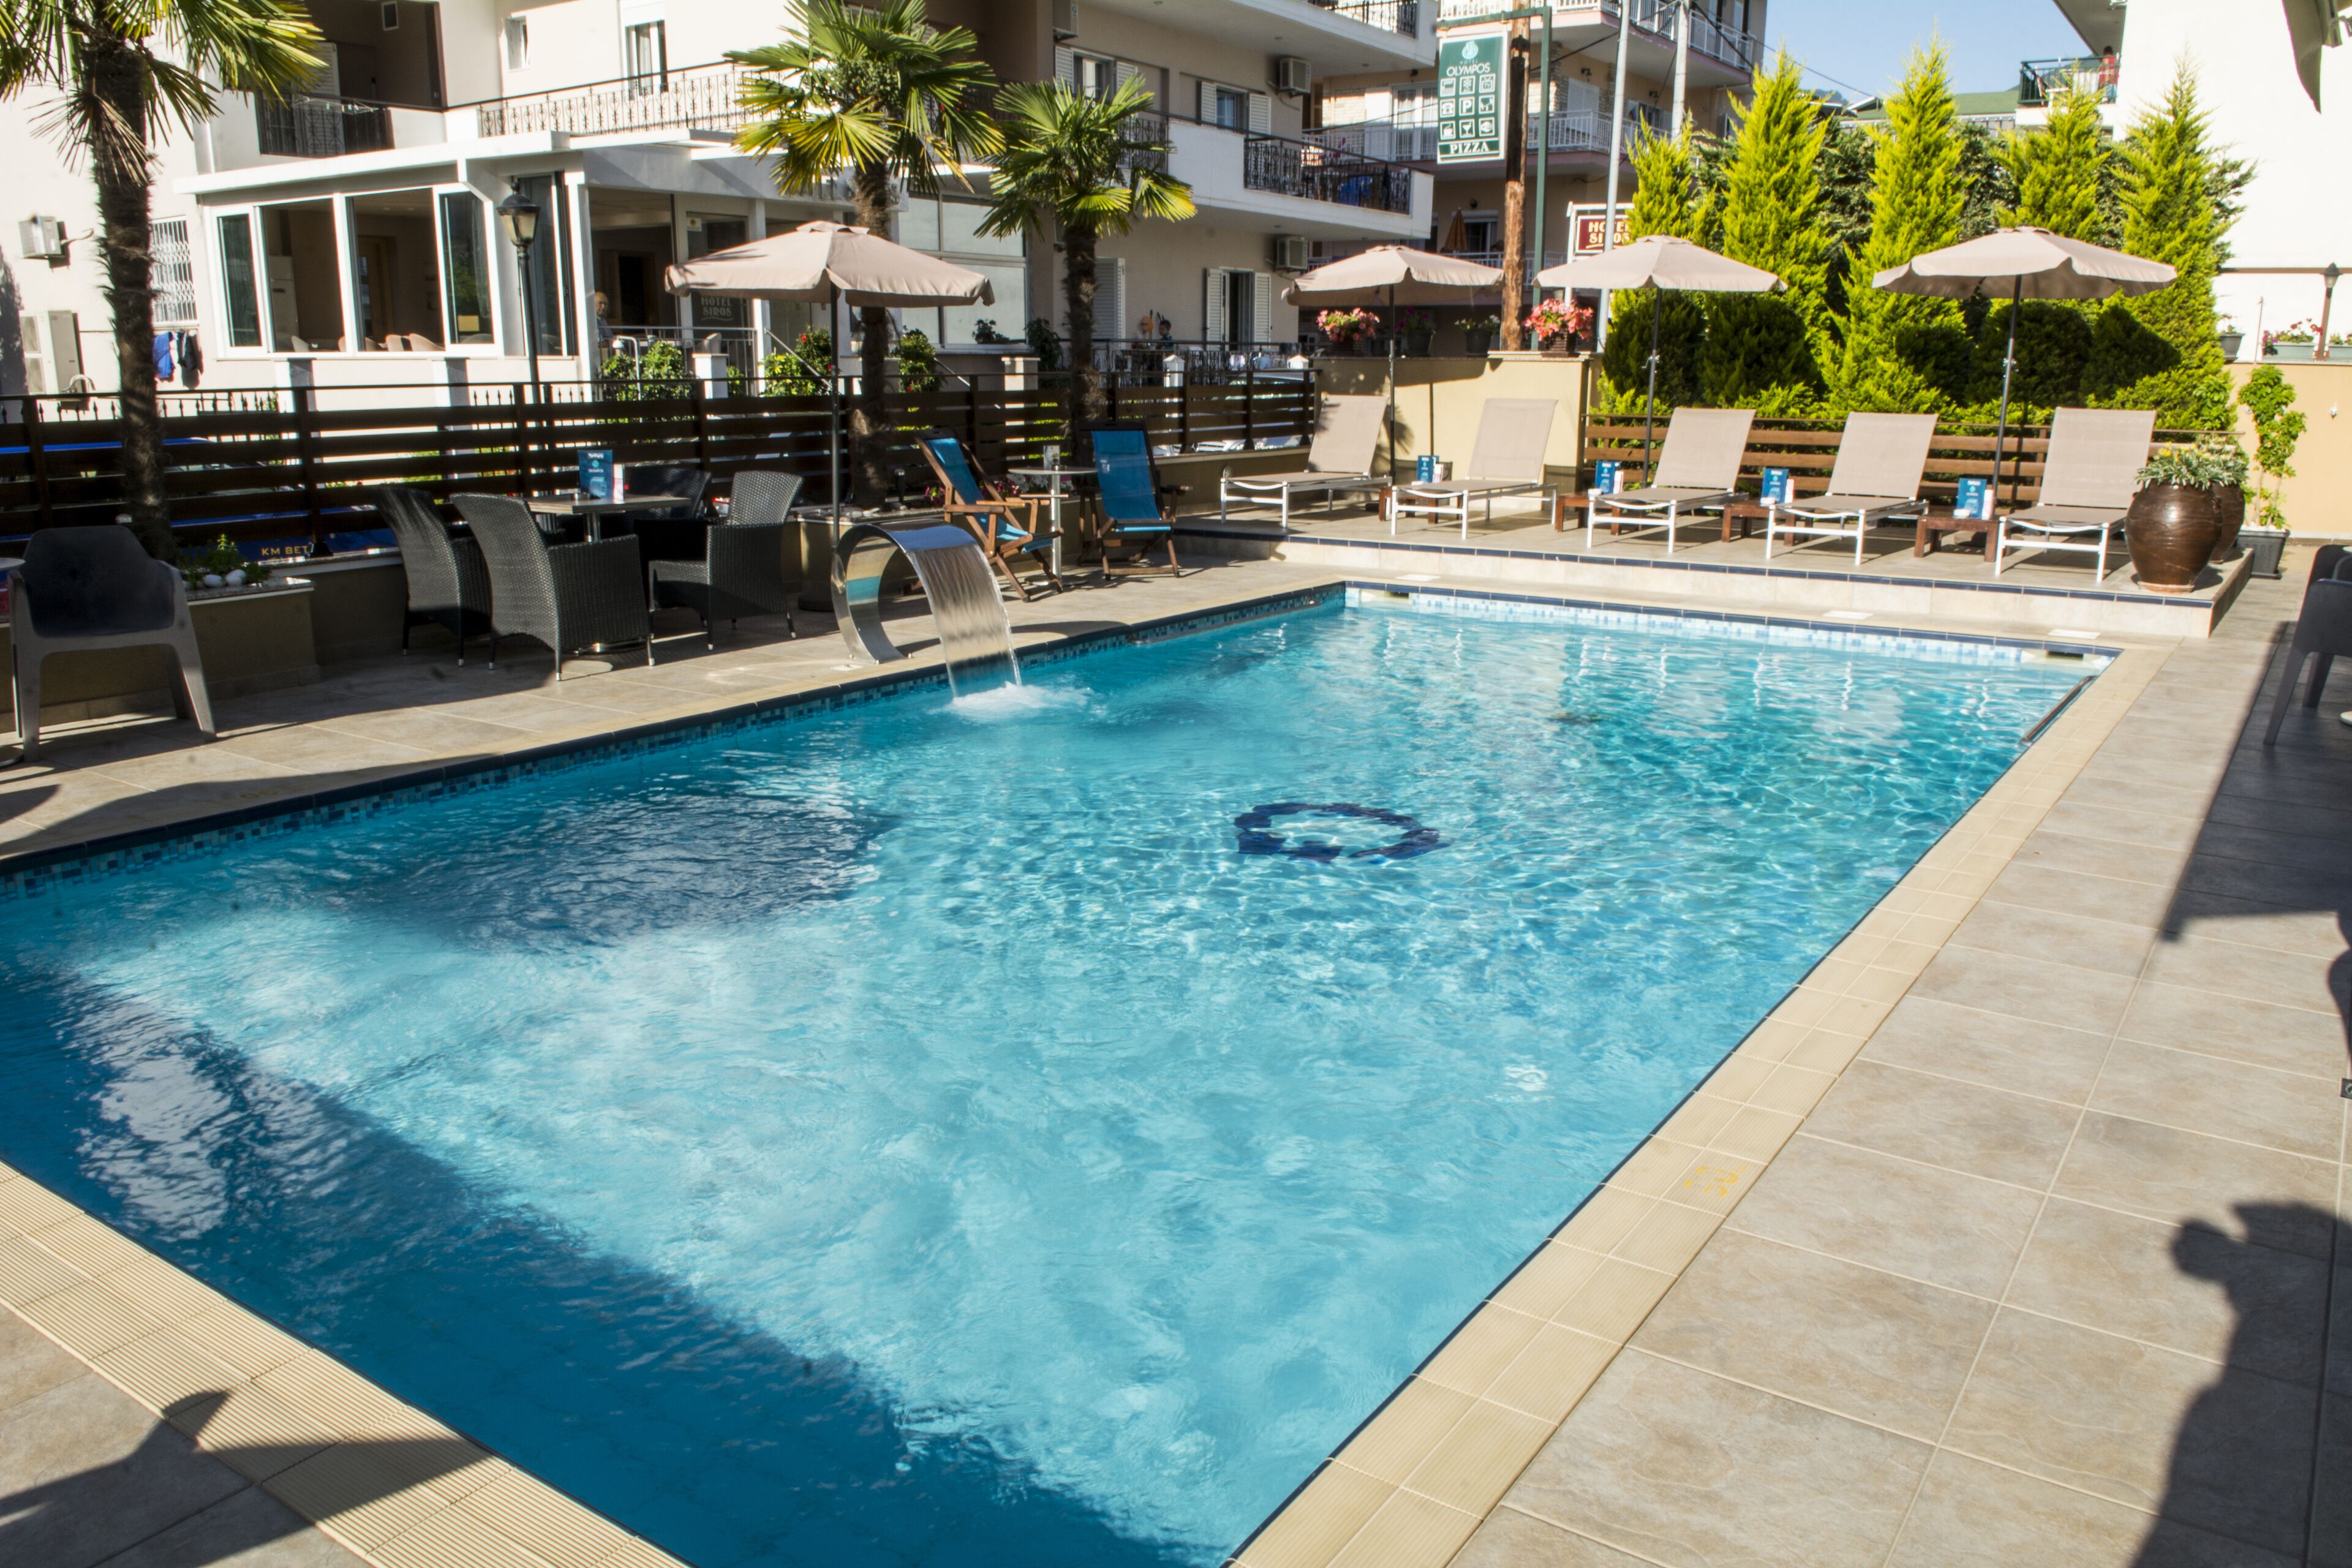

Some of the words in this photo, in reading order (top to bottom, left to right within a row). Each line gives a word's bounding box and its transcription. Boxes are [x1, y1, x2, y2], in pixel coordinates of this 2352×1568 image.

[1446, 62, 1491, 77] OLYMPOS
[1450, 141, 1490, 154] PIZZA
[1588, 221, 1630, 233] HOEL
[1589, 233, 1630, 244] SIOS
[701, 297, 733, 306] HOTEL
[703, 307, 732, 317] SIROS
